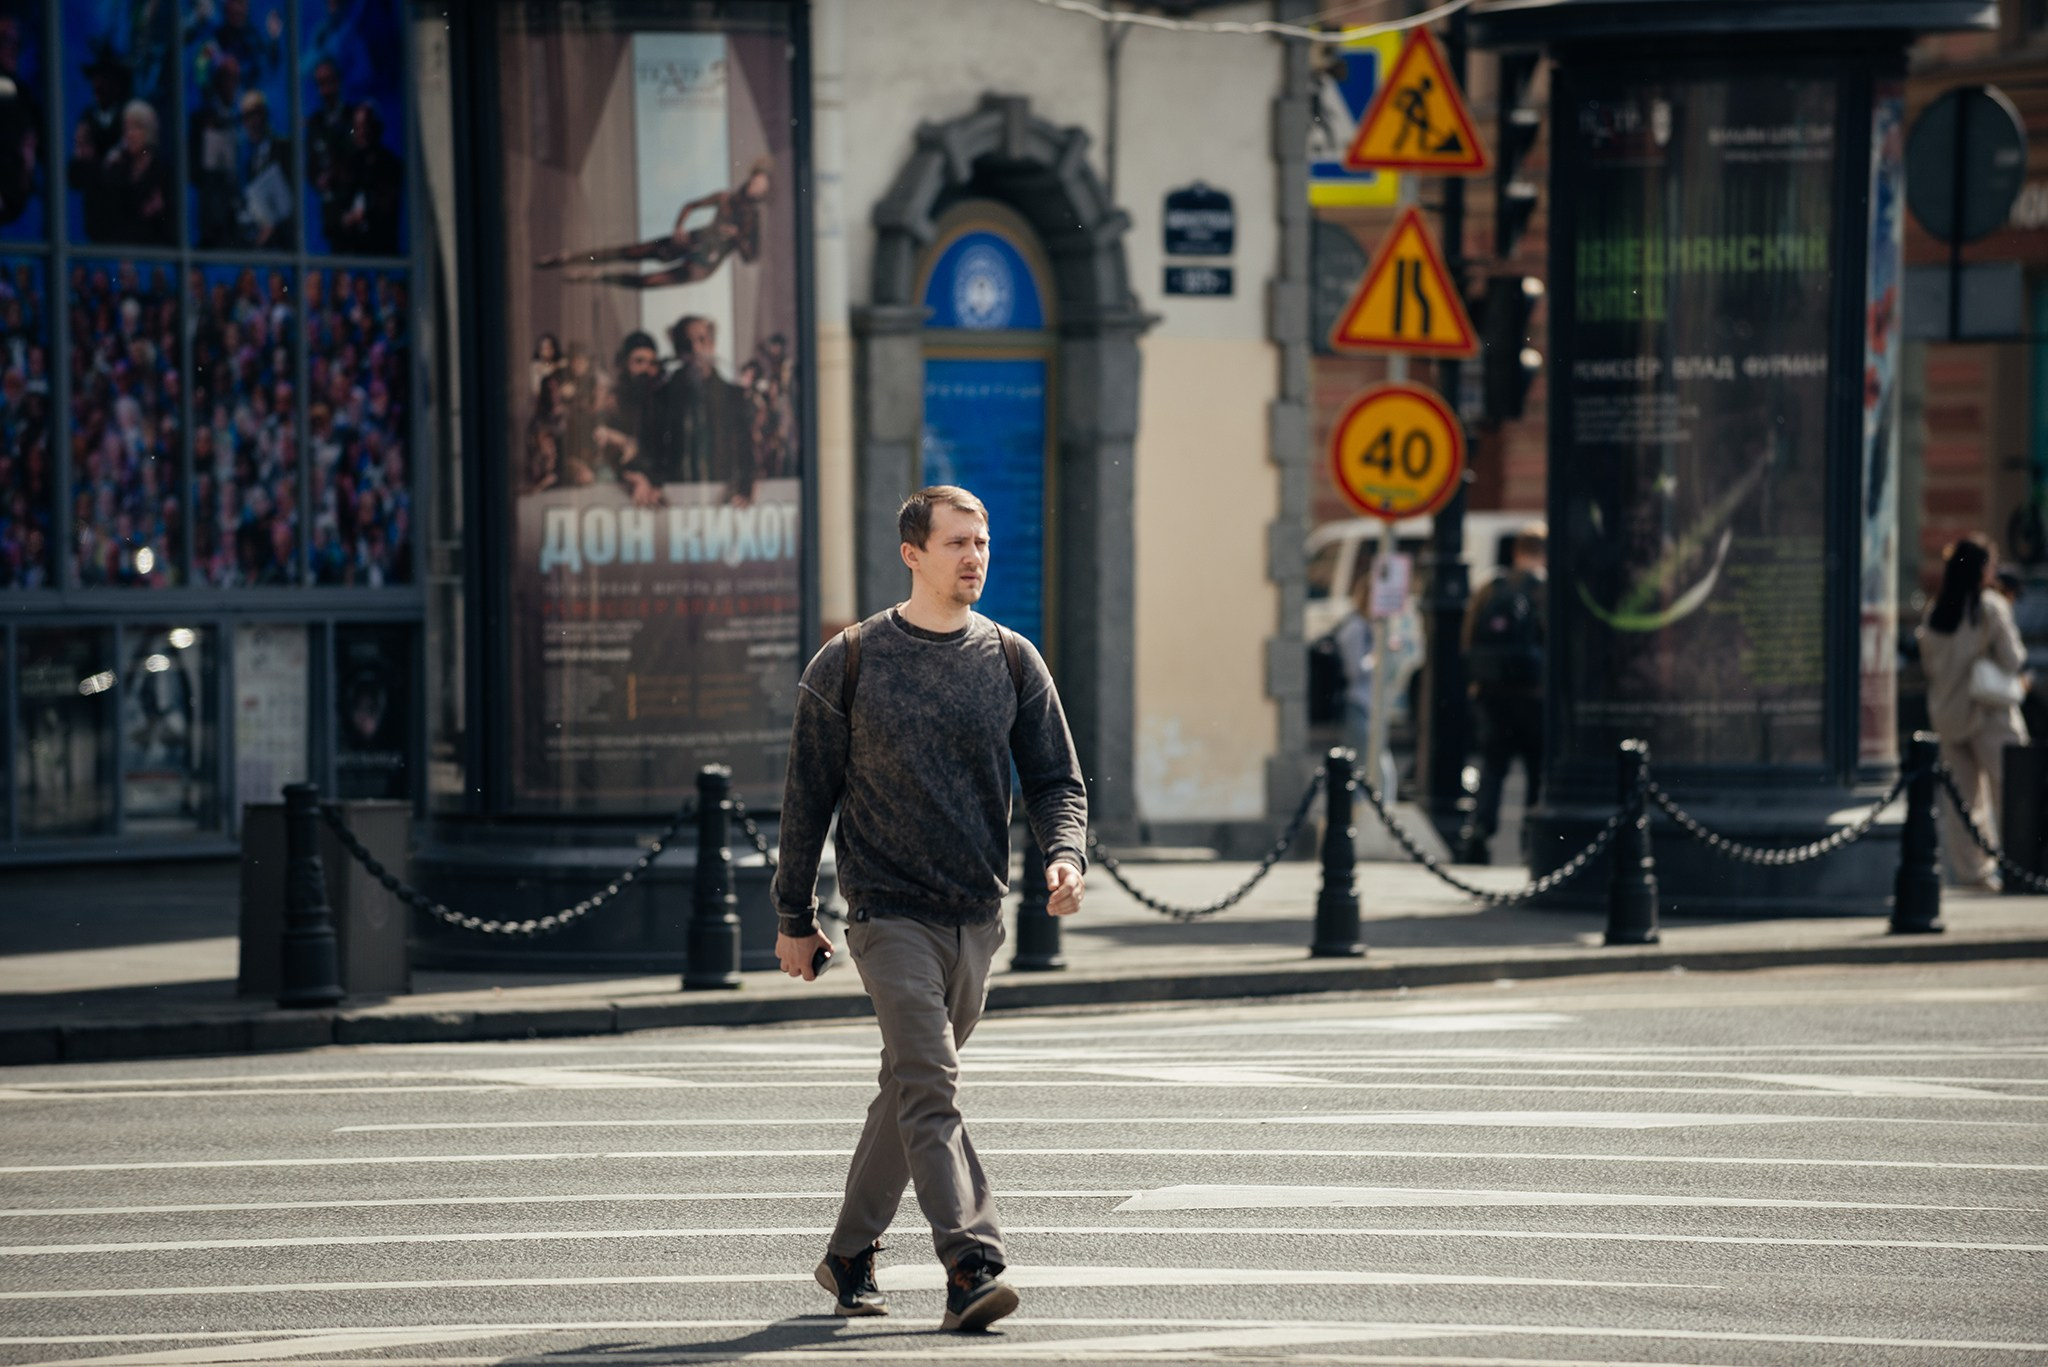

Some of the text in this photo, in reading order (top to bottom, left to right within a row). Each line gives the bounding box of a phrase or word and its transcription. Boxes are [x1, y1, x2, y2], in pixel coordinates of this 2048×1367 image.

[1362, 429, 1432, 479] 40
[540, 503, 798, 575] ДОН КИХОТ
